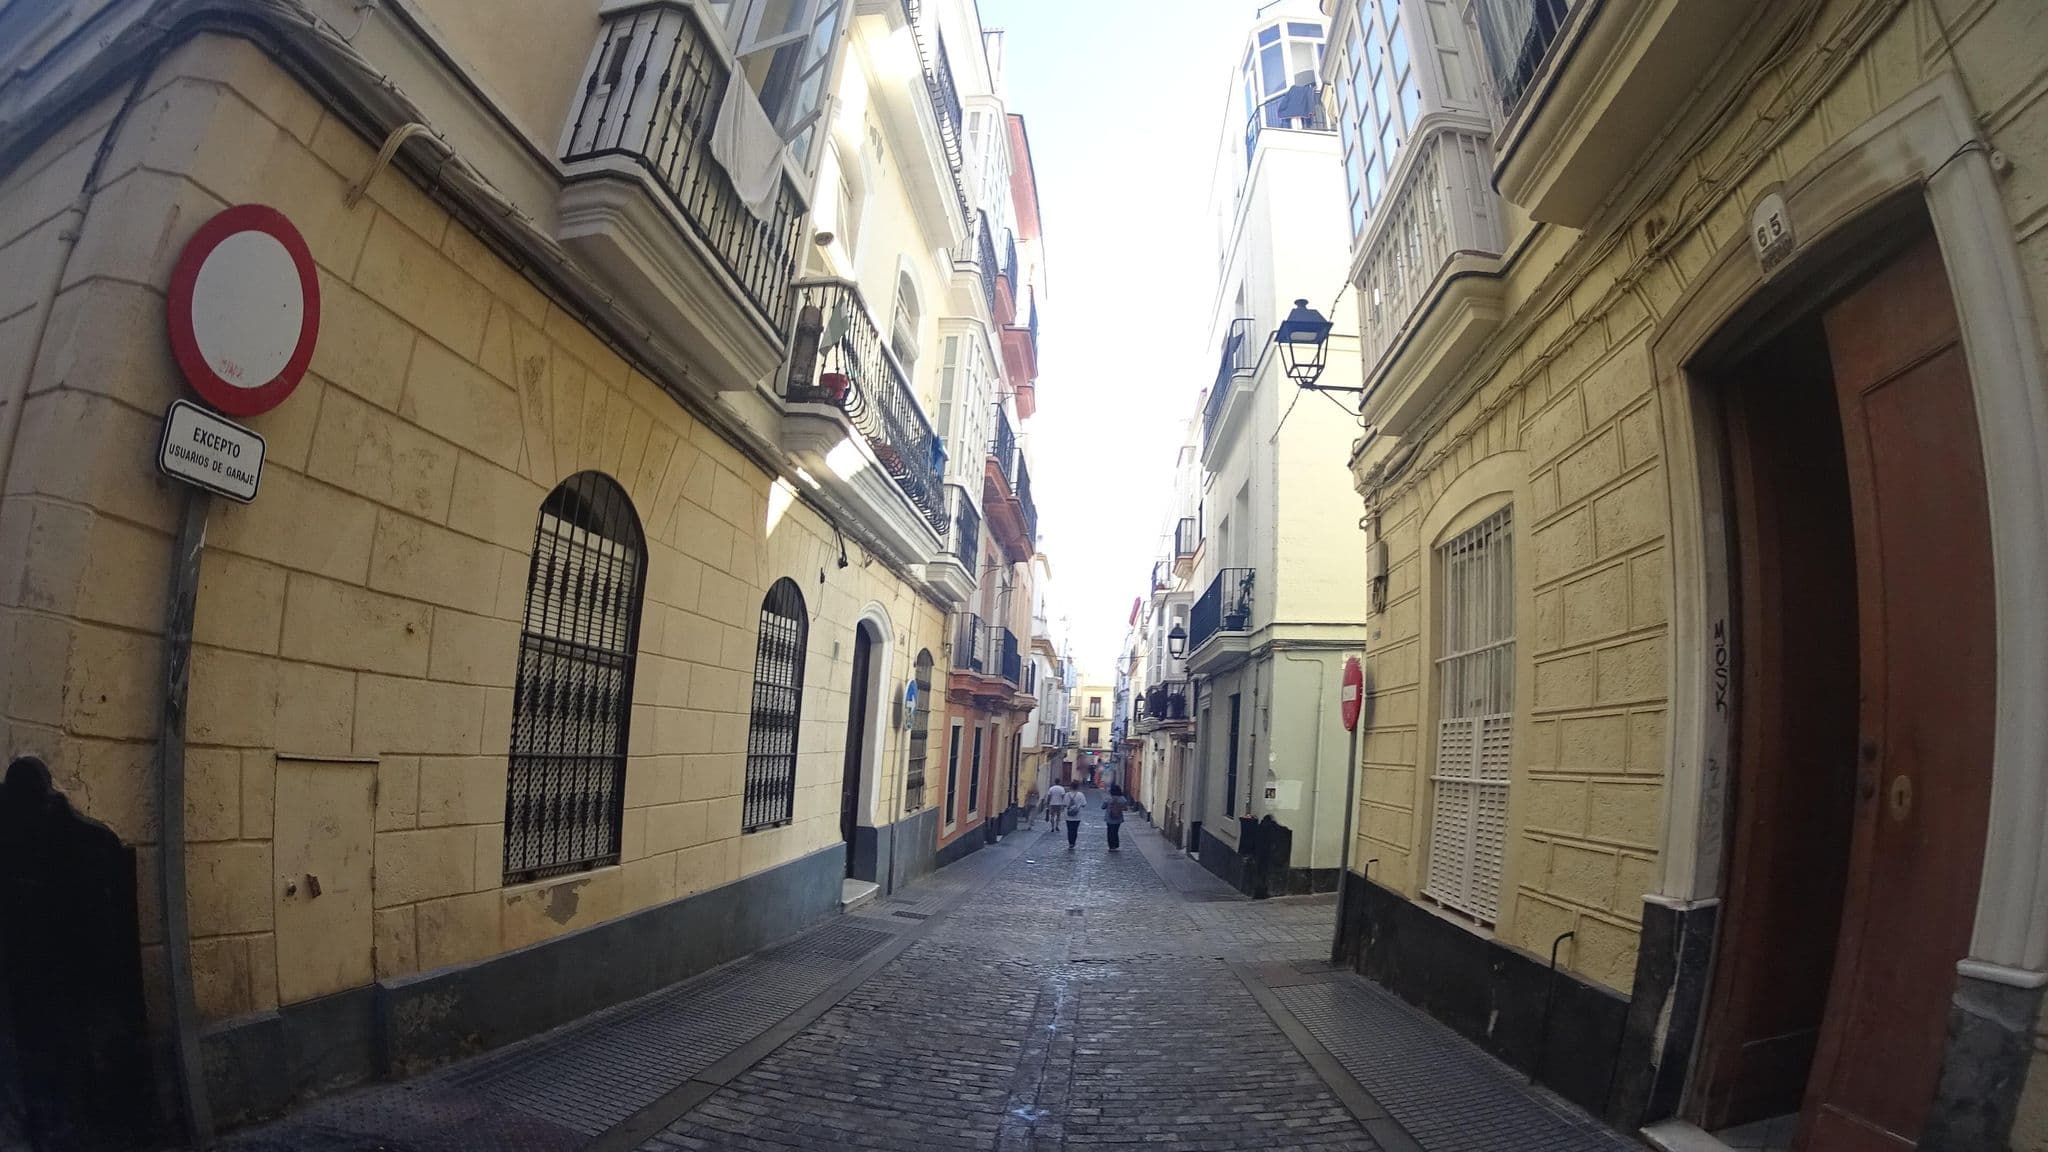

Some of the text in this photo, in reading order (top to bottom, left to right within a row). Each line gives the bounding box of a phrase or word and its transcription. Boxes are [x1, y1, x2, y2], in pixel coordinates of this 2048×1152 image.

[1757, 212, 1782, 248] 65
[193, 427, 241, 458] EXCEPTO
[168, 443, 255, 485] USUARIOS DE GARAJE
